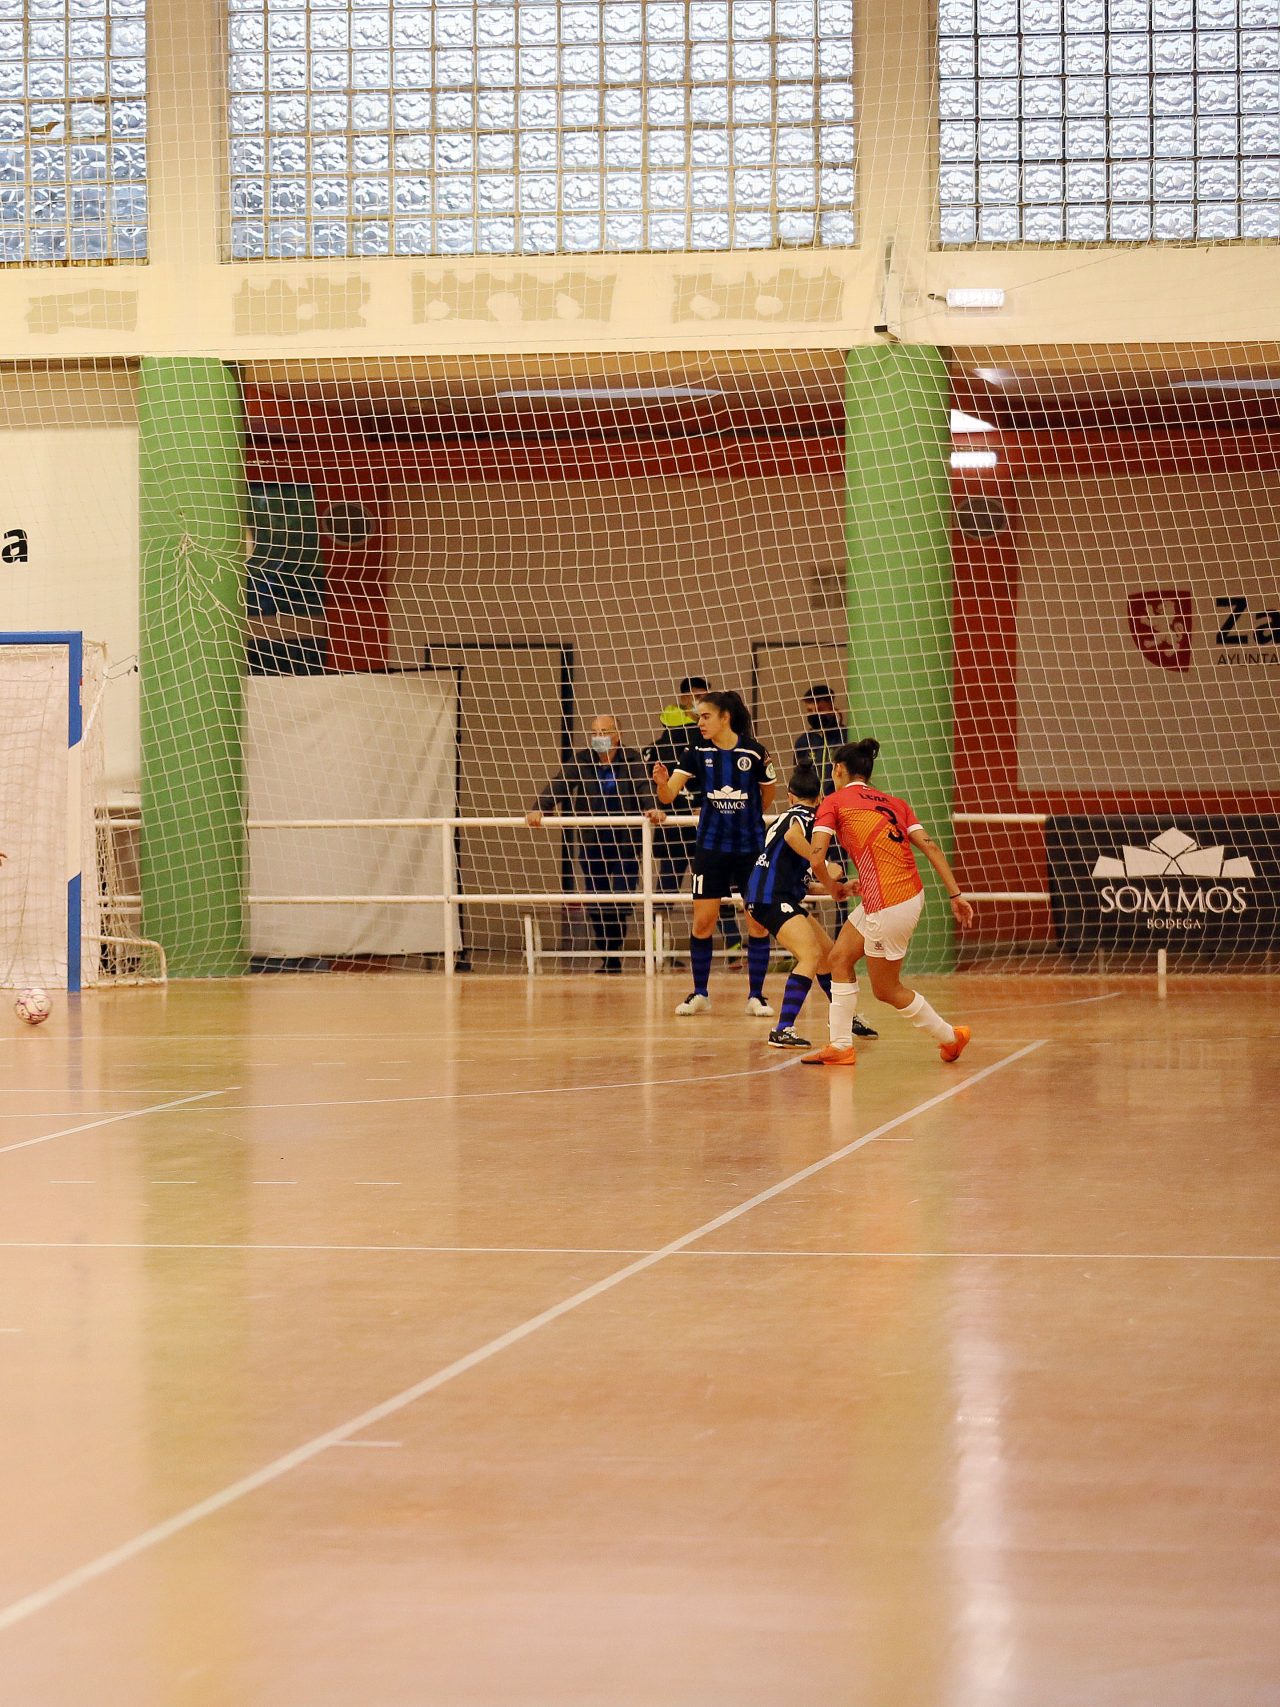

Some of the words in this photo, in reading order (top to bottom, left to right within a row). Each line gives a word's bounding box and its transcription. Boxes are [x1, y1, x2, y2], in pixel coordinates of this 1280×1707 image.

[711, 800, 746, 810] OMMOS
[875, 805, 904, 843] 3
[1100, 886, 1247, 914] SOMMOS
[1146, 917, 1201, 930] BODEGA
